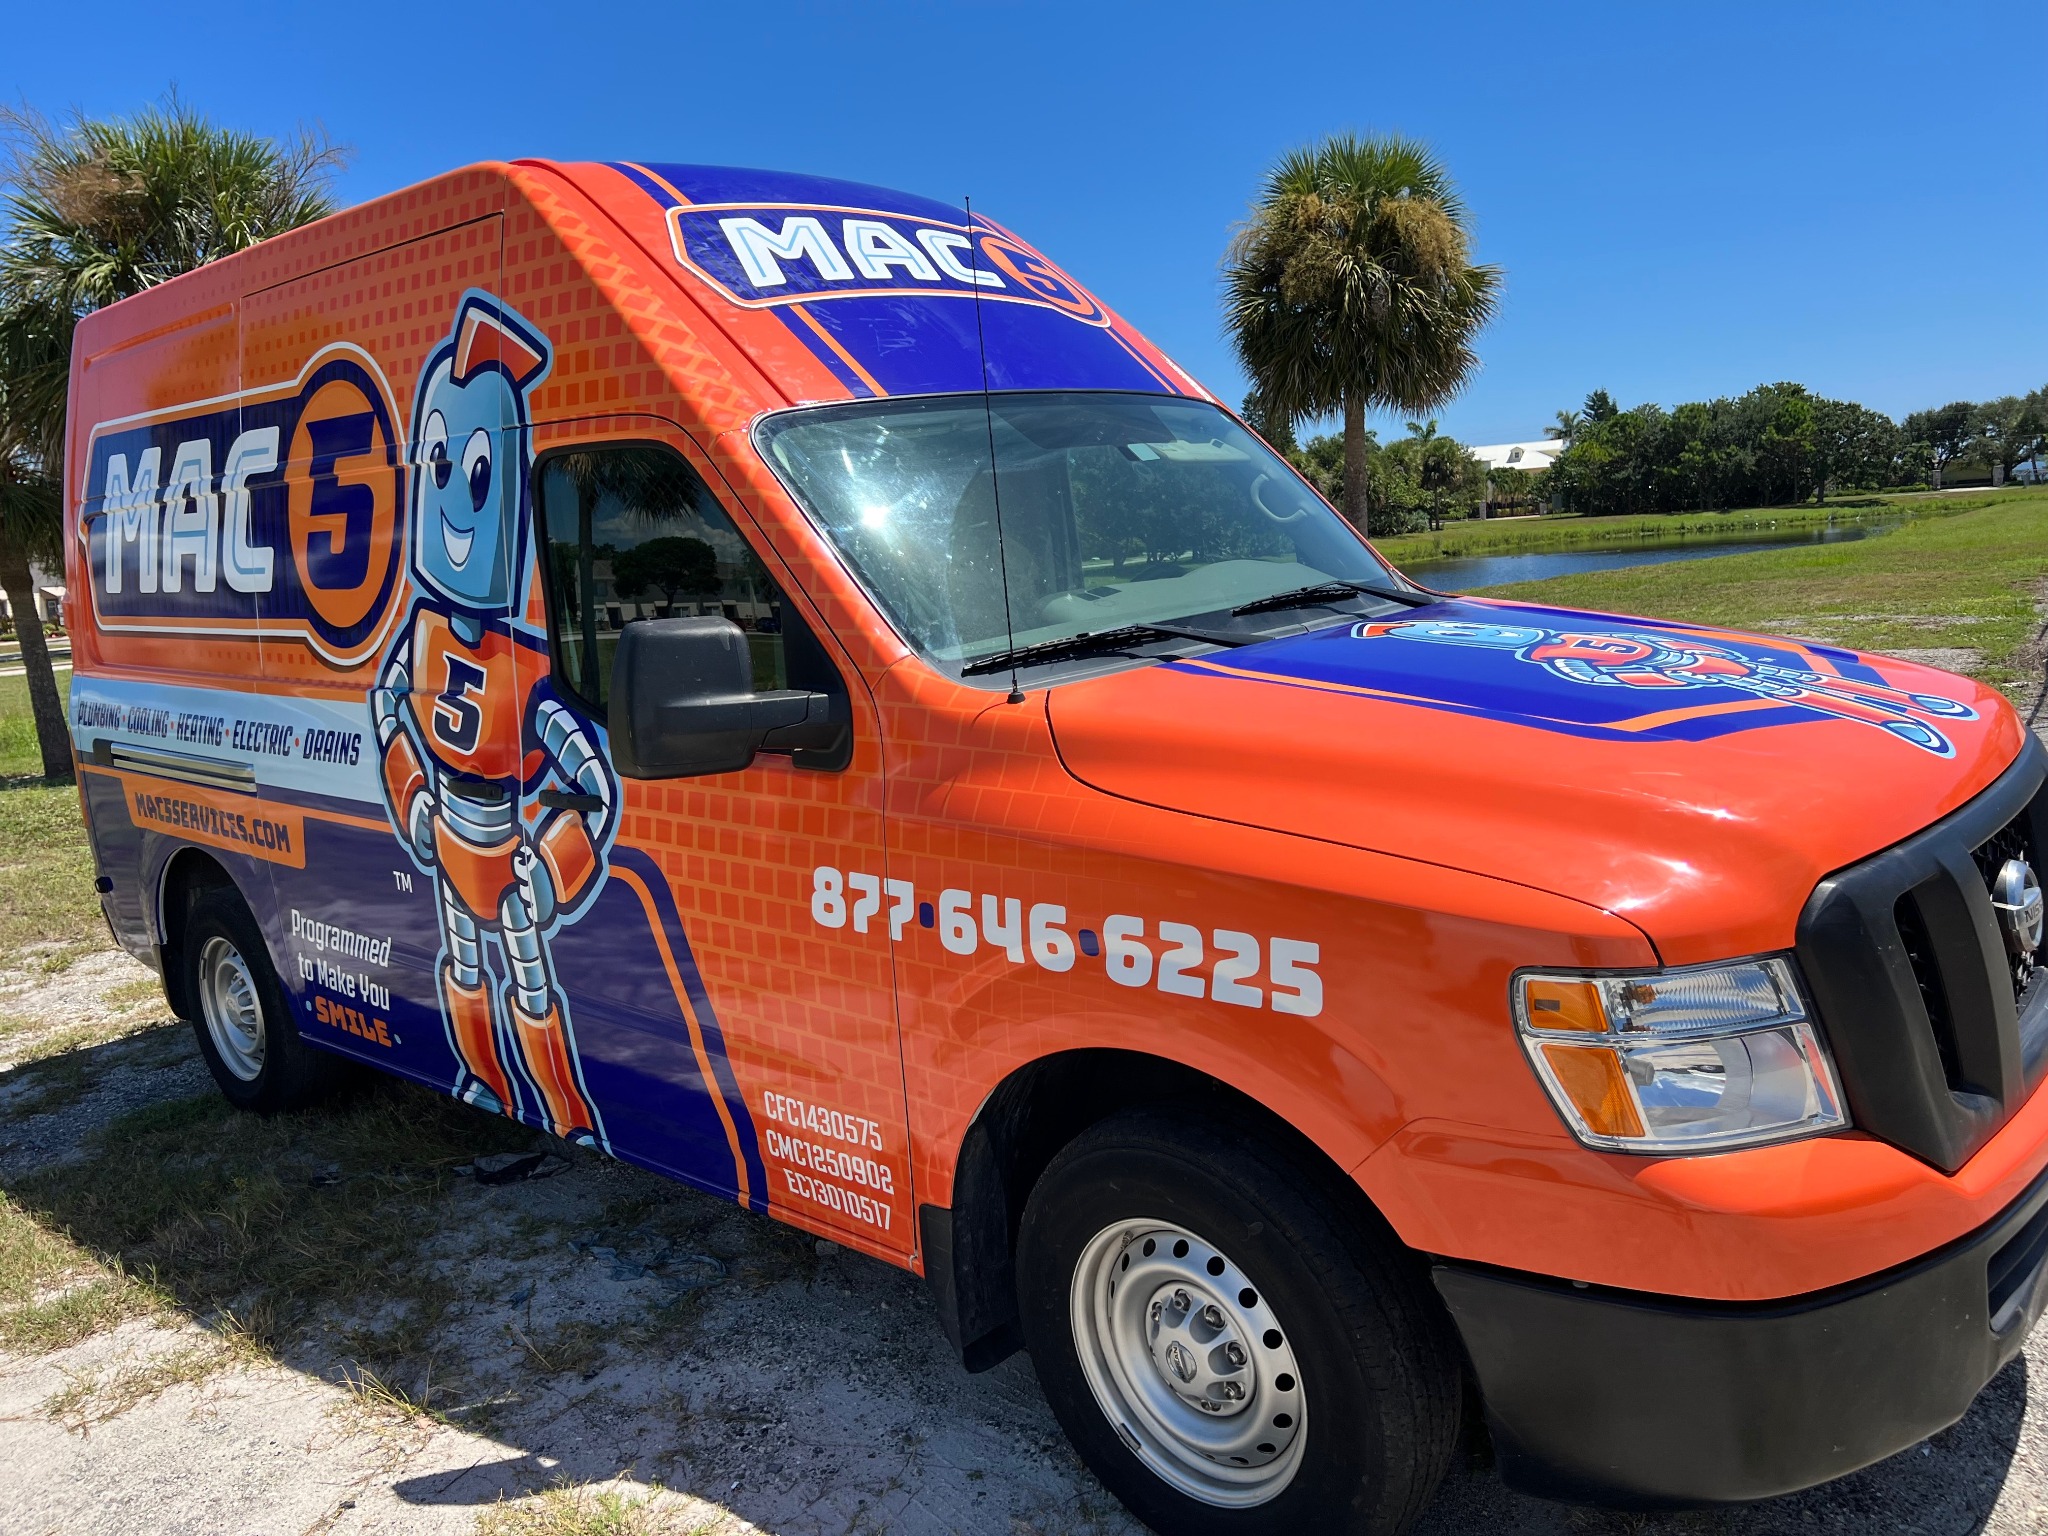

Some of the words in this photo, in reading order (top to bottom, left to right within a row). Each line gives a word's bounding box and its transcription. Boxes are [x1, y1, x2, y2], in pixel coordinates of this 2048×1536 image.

[79, 700, 122, 730] PLUMBING
[127, 705, 170, 738] COOLING
[176, 712, 224, 746] HEATING
[232, 719, 295, 756] ELECTRIC
[302, 728, 362, 766] DRAINS
[432, 650, 487, 756] 5
[393, 870, 413, 894] TM
[291, 908, 391, 968] Programmed
[298, 951, 315, 983] to
[317, 957, 355, 999] Make
[359, 973, 391, 1012] You
[315, 996, 392, 1048] SMILE
[764, 1090, 883, 1152] CFC1430575
[766, 1129, 895, 1196] CMC1250902
[783, 1167, 891, 1231] EC13010517
